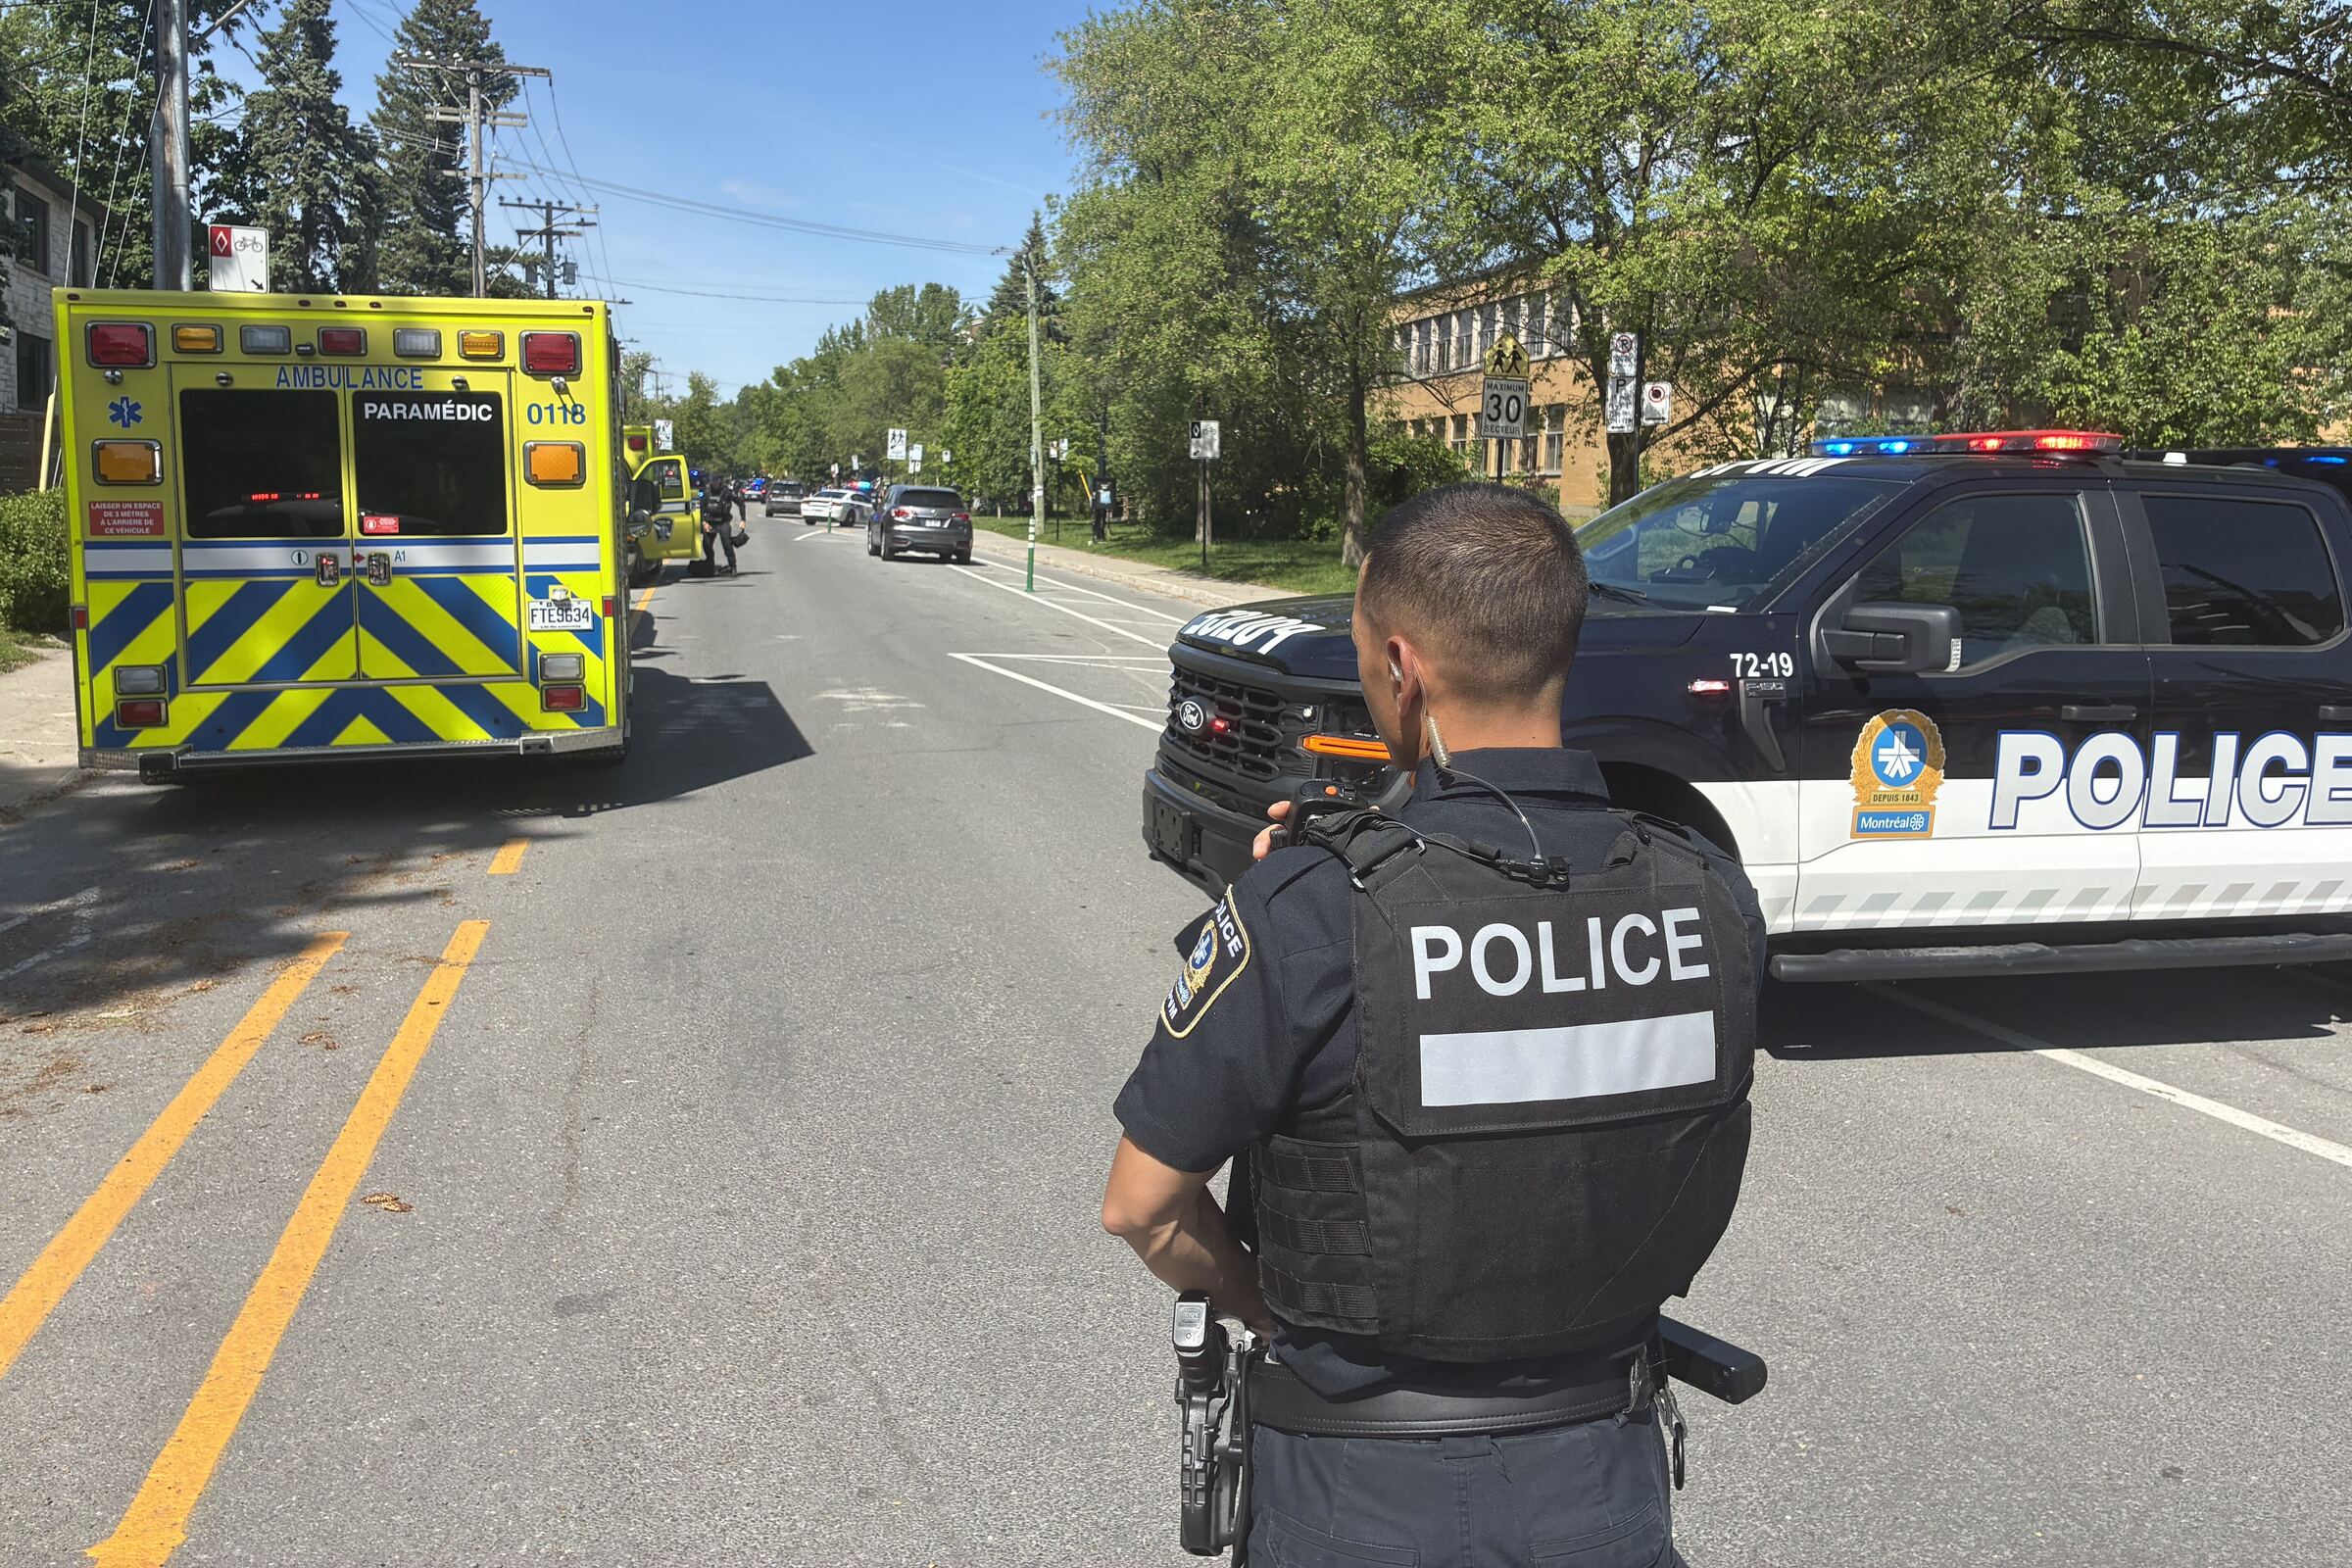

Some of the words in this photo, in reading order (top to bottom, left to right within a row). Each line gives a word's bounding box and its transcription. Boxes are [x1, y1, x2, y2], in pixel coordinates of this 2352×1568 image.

[275, 366, 423, 390] AMBULANCE
[1486, 382, 1525, 392] MAXIMUM
[1616, 378, 1626, 393] P
[364, 400, 493, 421] PARAMÉDIC
[526, 403, 587, 425] 0118
[1486, 393, 1522, 423] 30
[1484, 424, 1521, 435] SECTEUR
[394, 550, 406, 563] A1
[530, 607, 589, 623] FTE9634
[1730, 652, 1793, 677] 72-19
[1987, 729, 2352, 831] POLICE
[1873, 794, 1899, 803] DEPUIS
[1860, 816, 1910, 829] Montréal
[1410, 907, 1710, 1000] POLICE
